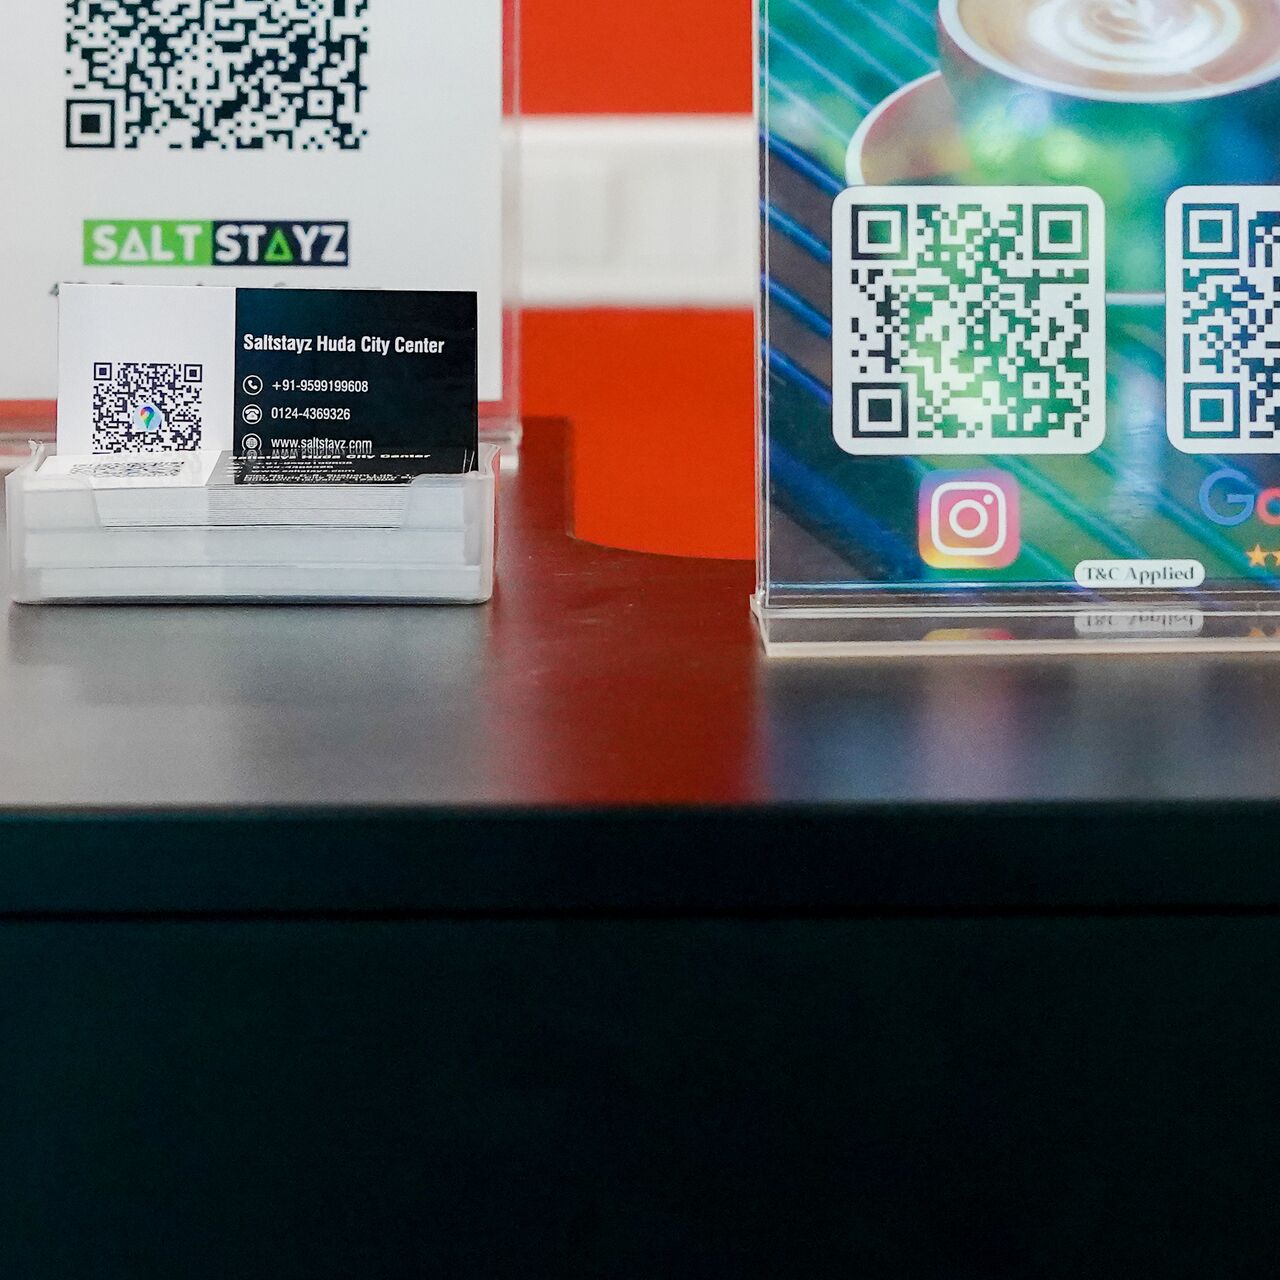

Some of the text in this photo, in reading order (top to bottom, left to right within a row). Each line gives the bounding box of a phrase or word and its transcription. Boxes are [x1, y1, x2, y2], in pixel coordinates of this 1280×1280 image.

[92, 224, 347, 263] SALT STAYZ
[243, 333, 444, 356] Saltstayz Huda City Center
[272, 379, 369, 393] +91-9599199608
[271, 407, 351, 421] 0124-4369326
[271, 436, 372, 451] www.saltstayz.com
[1083, 566, 1195, 585] T&C Applied
